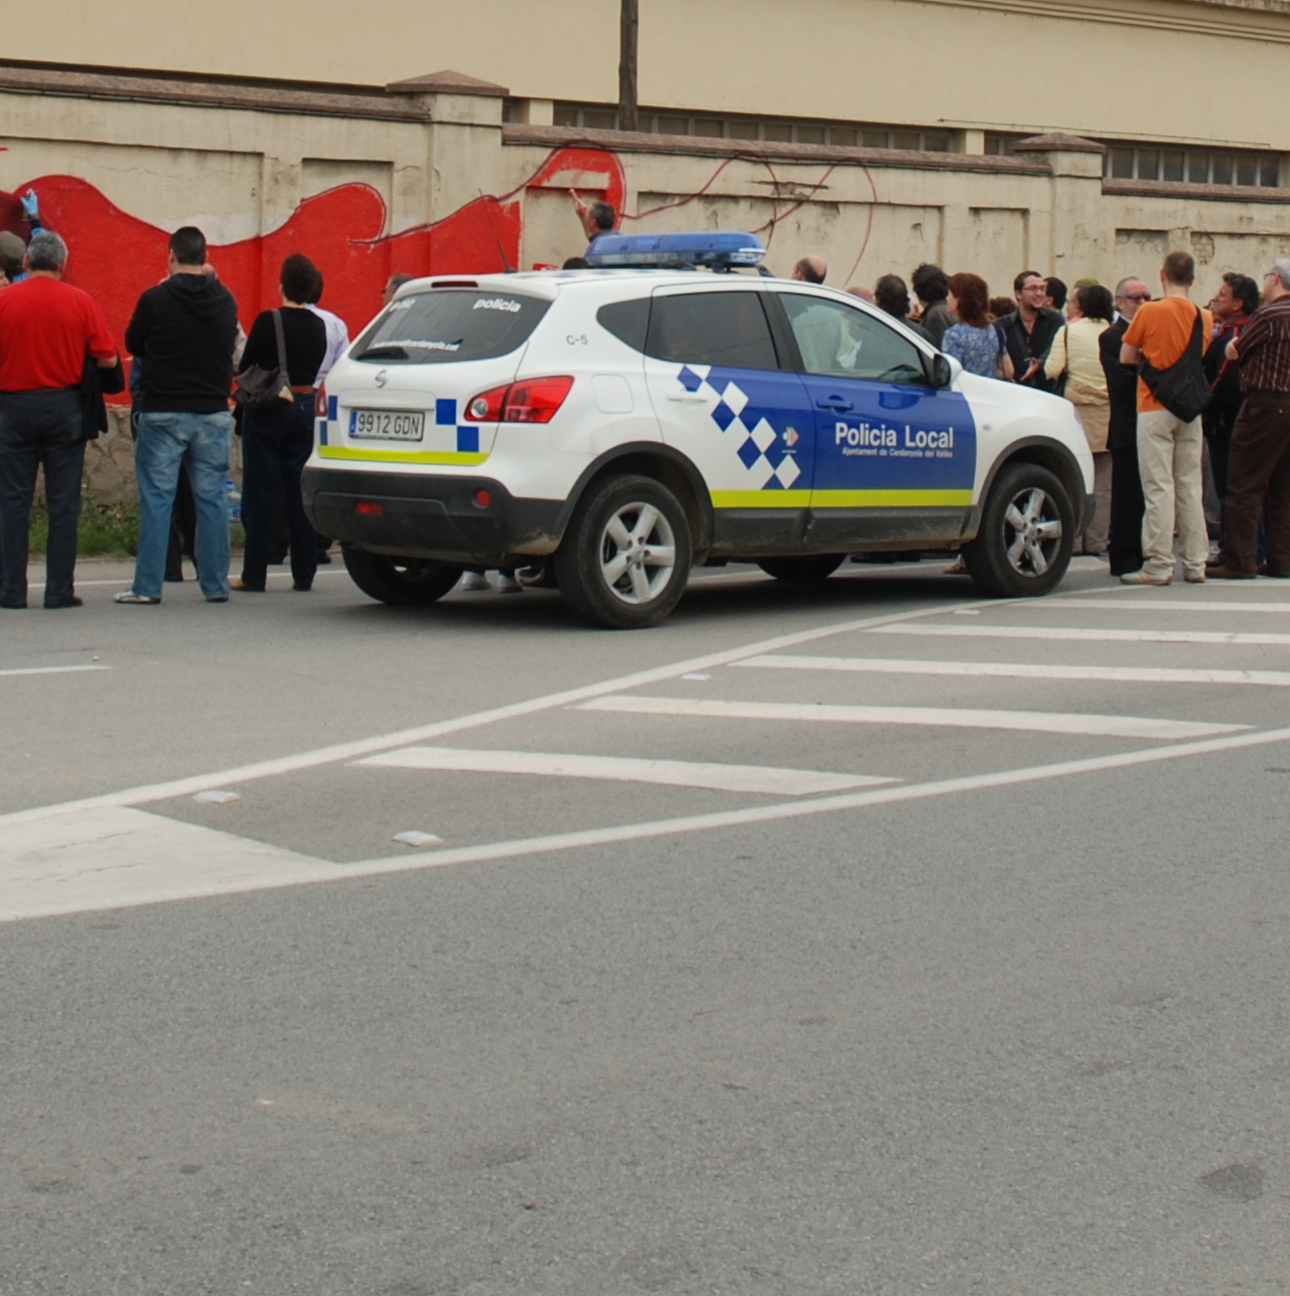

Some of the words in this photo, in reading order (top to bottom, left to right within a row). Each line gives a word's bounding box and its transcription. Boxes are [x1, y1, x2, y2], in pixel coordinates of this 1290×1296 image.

[472, 297, 522, 313] policia
[358, 413, 391, 434] 9912
[394, 415, 420, 435] GDN
[835, 422, 897, 446] Policia
[905, 424, 954, 448] Local
